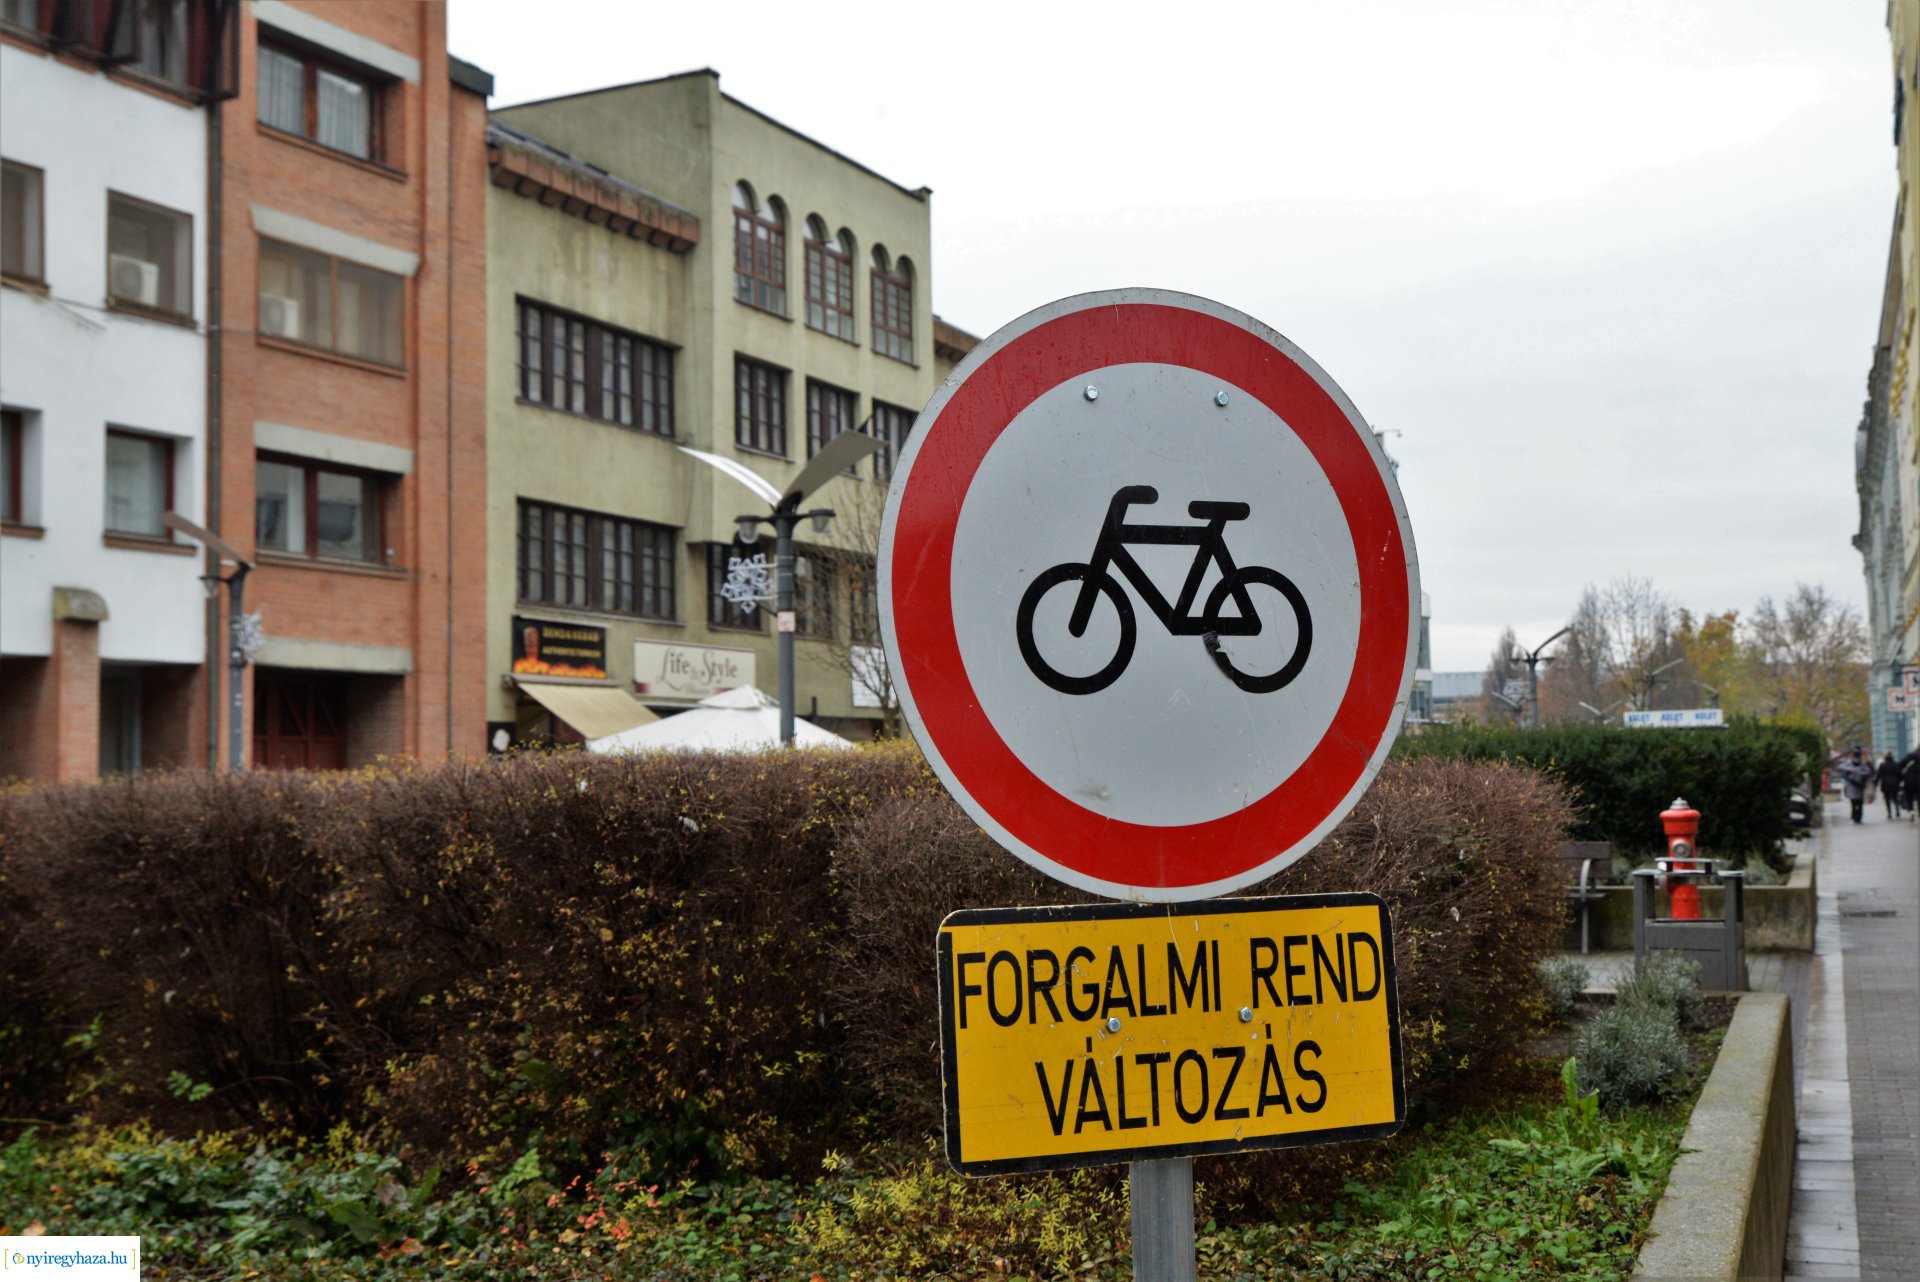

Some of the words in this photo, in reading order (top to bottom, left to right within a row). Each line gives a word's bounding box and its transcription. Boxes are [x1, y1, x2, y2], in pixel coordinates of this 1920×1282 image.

[656, 647, 690, 691] Life
[701, 650, 737, 685] Style
[957, 940, 1222, 1029] FORGALMI
[1250, 931, 1381, 1009] REND
[1035, 1023, 1327, 1136] VÁLTOZÁS
